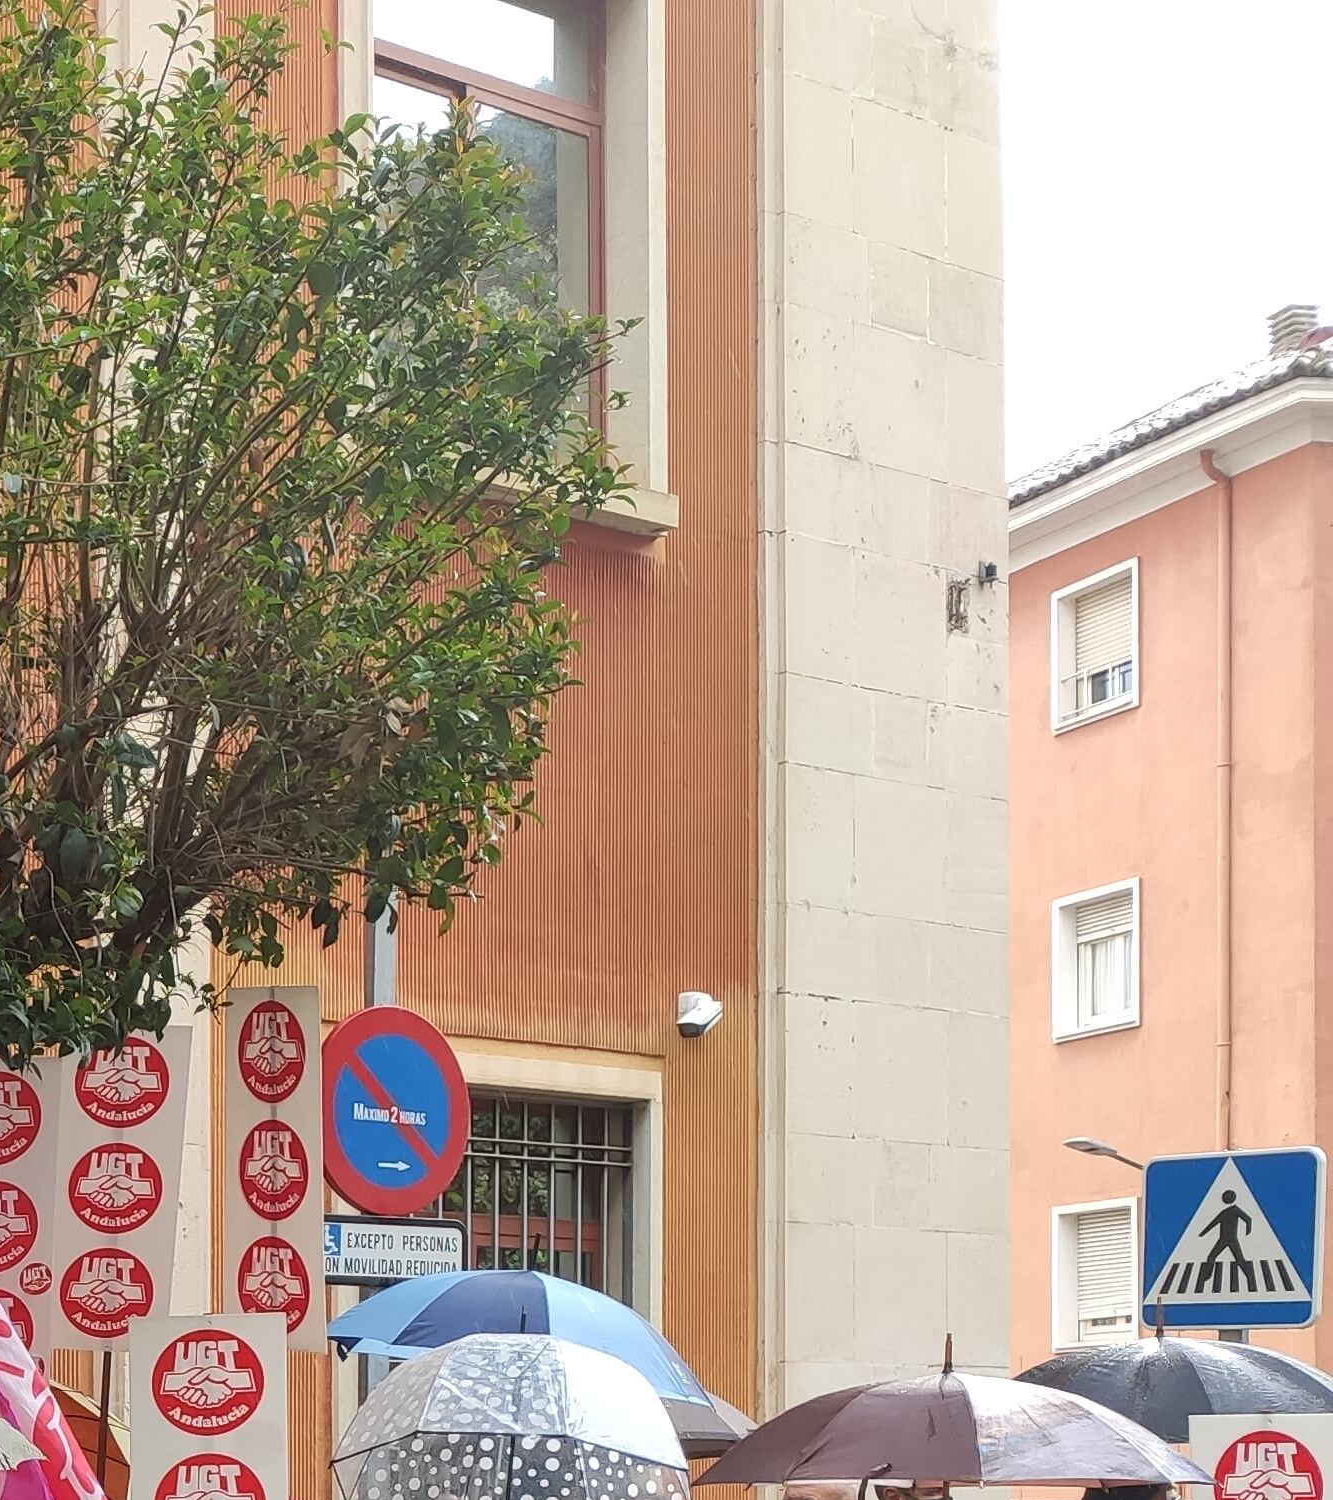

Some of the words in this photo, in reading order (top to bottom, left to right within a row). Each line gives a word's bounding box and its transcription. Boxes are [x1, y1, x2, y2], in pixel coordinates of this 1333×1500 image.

[251, 1010, 289, 1041] UGT
[96, 1046, 151, 1073] UGT
[247, 1072, 297, 1095] Andalucía
[85, 1101, 155, 1122] Andalucía
[390, 1106, 399, 1124] 2
[399, 1109, 427, 1126] HORAS
[252, 1129, 295, 1160] UGT
[89, 1152, 144, 1180] UGT
[248, 1188, 301, 1214] Andalucía
[81, 1207, 149, 1228] Andalucía
[347, 1232, 394, 1251] EXCEPTO
[402, 1234, 458, 1254] PERSONAS
[81, 1256, 135, 1284] UGT
[251, 1244, 295, 1275] UGT
[324, 1257, 340, 1274] ON
[344, 1258, 403, 1276] MOVILIDAD
[22, 1266, 50, 1282] UGT
[71, 1312, 130, 1332] Andaluc
[174, 1339, 240, 1373] UGT
[167, 1401, 251, 1429] Andalucía
[1235, 1441, 1299, 1474] UGT
[176, 1464, 242, 1496] UGT
